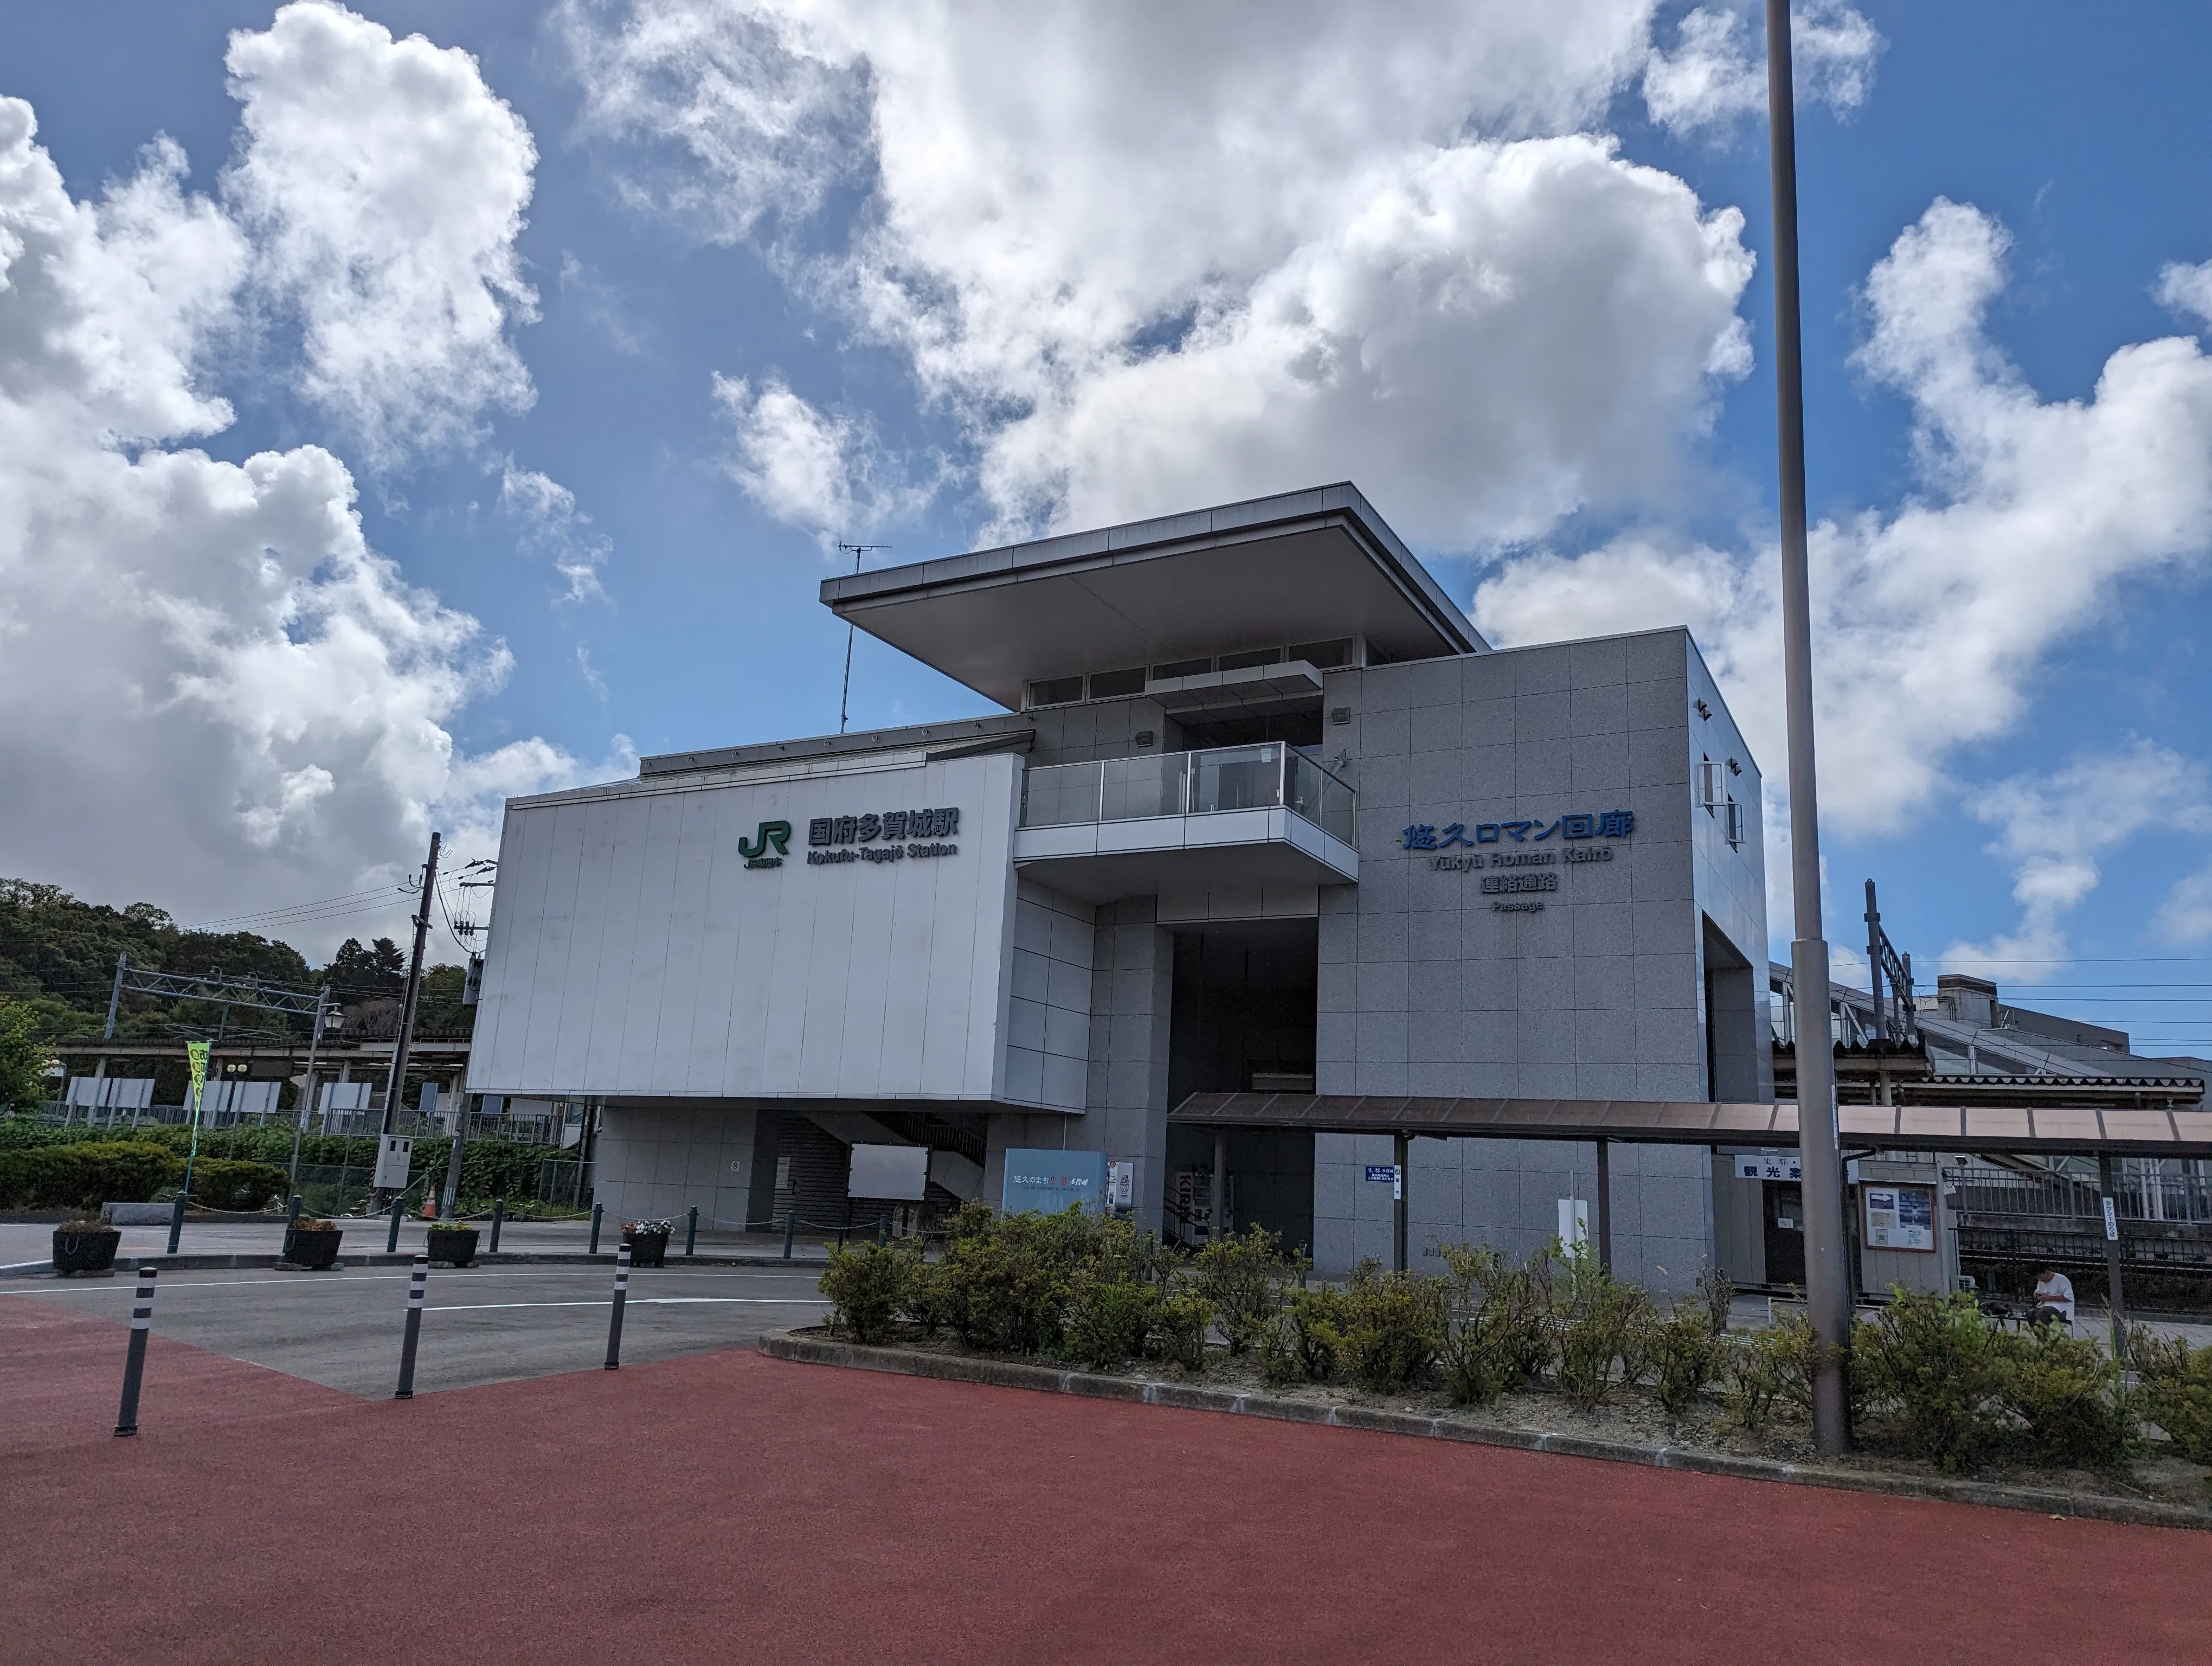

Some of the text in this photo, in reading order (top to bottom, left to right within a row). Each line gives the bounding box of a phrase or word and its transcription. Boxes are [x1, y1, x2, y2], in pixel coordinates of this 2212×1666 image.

[808, 808, 959, 846] 国府多賀城駅
[1402, 809, 1635, 850] 悠久ロマン回廊
[738, 820, 791, 857] JR
[906, 843, 958, 857] Station
[744, 857, 783, 869] JR東日本
[1490, 853, 1556, 868] Roman
[1481, 873, 1557, 894] 連絡通路
[1493, 901, 1544, 912] Passage
[1744, 1165, 1801, 1179] 観光案
[2106, 1201, 2115, 1237] タクシーのりば
